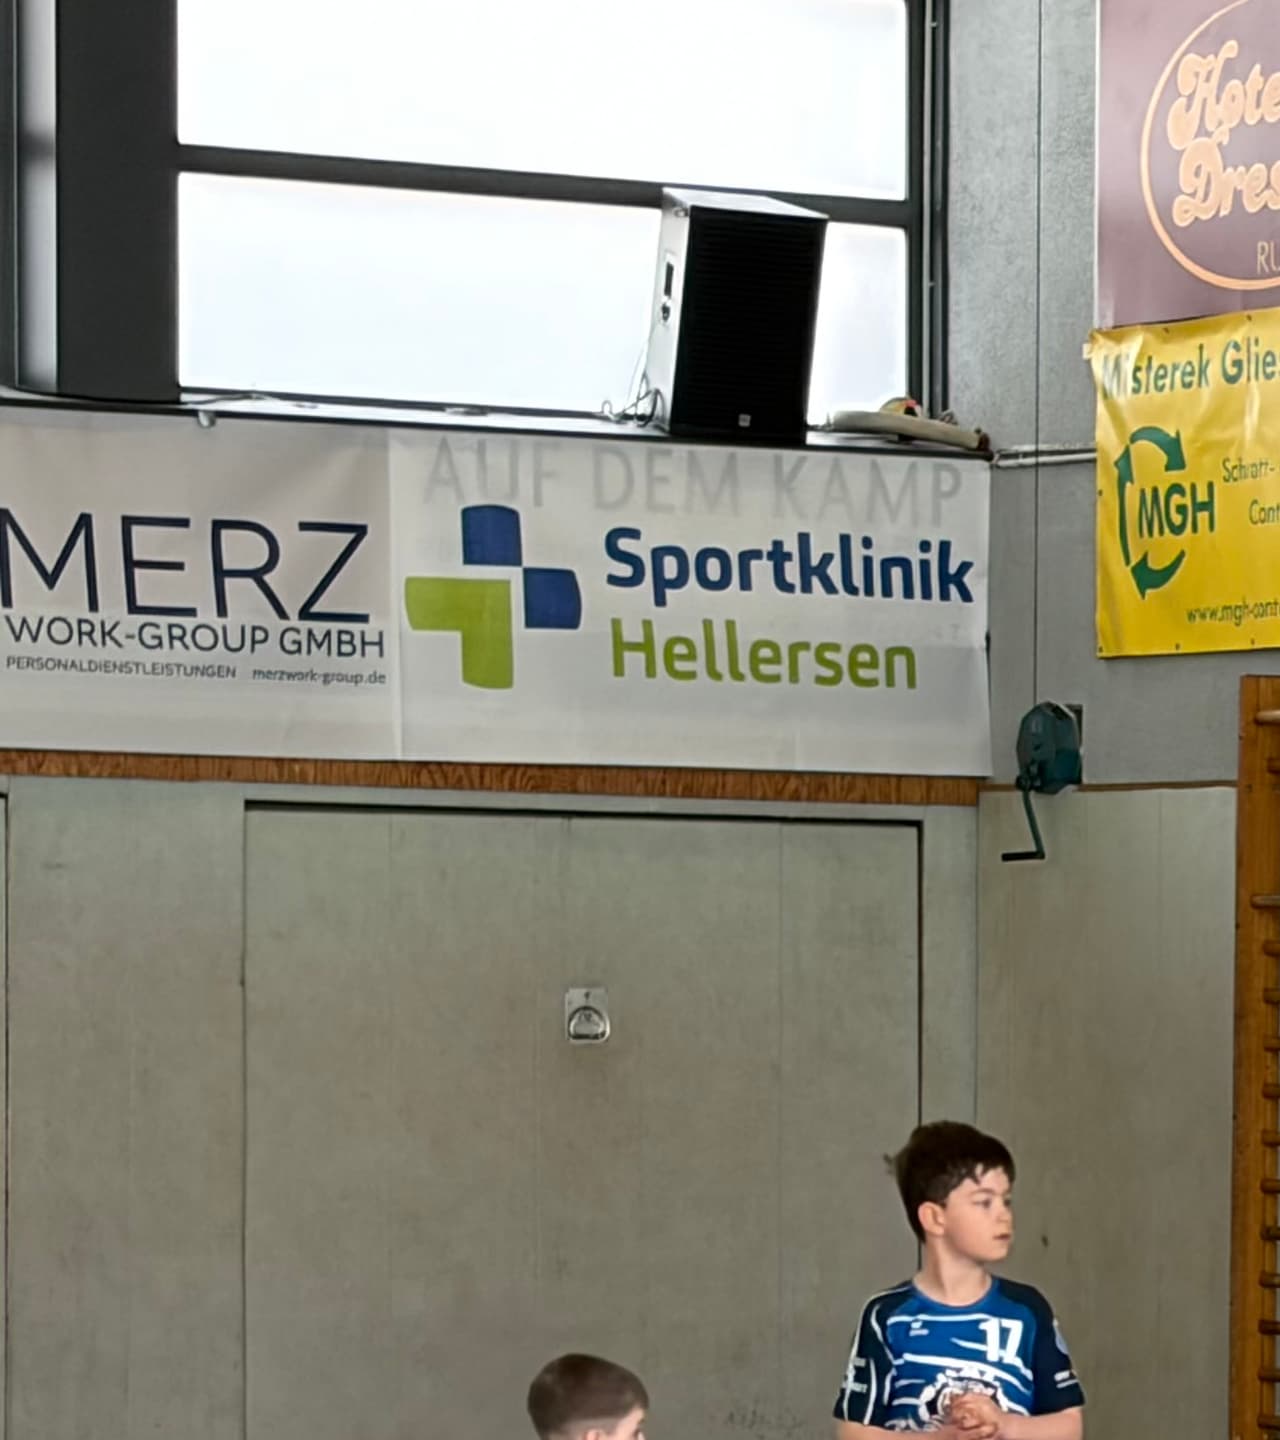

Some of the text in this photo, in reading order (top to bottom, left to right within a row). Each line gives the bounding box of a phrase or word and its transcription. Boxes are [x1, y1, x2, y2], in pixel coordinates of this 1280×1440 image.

[426, 436, 963, 529] AUF DEM KAMP
[1138, 481, 1215, 538] MGH
[0, 507, 370, 624] MERZ
[605, 527, 974, 607] Sportklinik
[5, 614, 385, 658] WORK-GROUP GMBH
[611, 617, 917, 689] Hellersen
[6, 656, 386, 686] PERSONALDIENSTLEISTUNGEN merzwork-group.de
[979, 1318, 1024, 1362] 17
